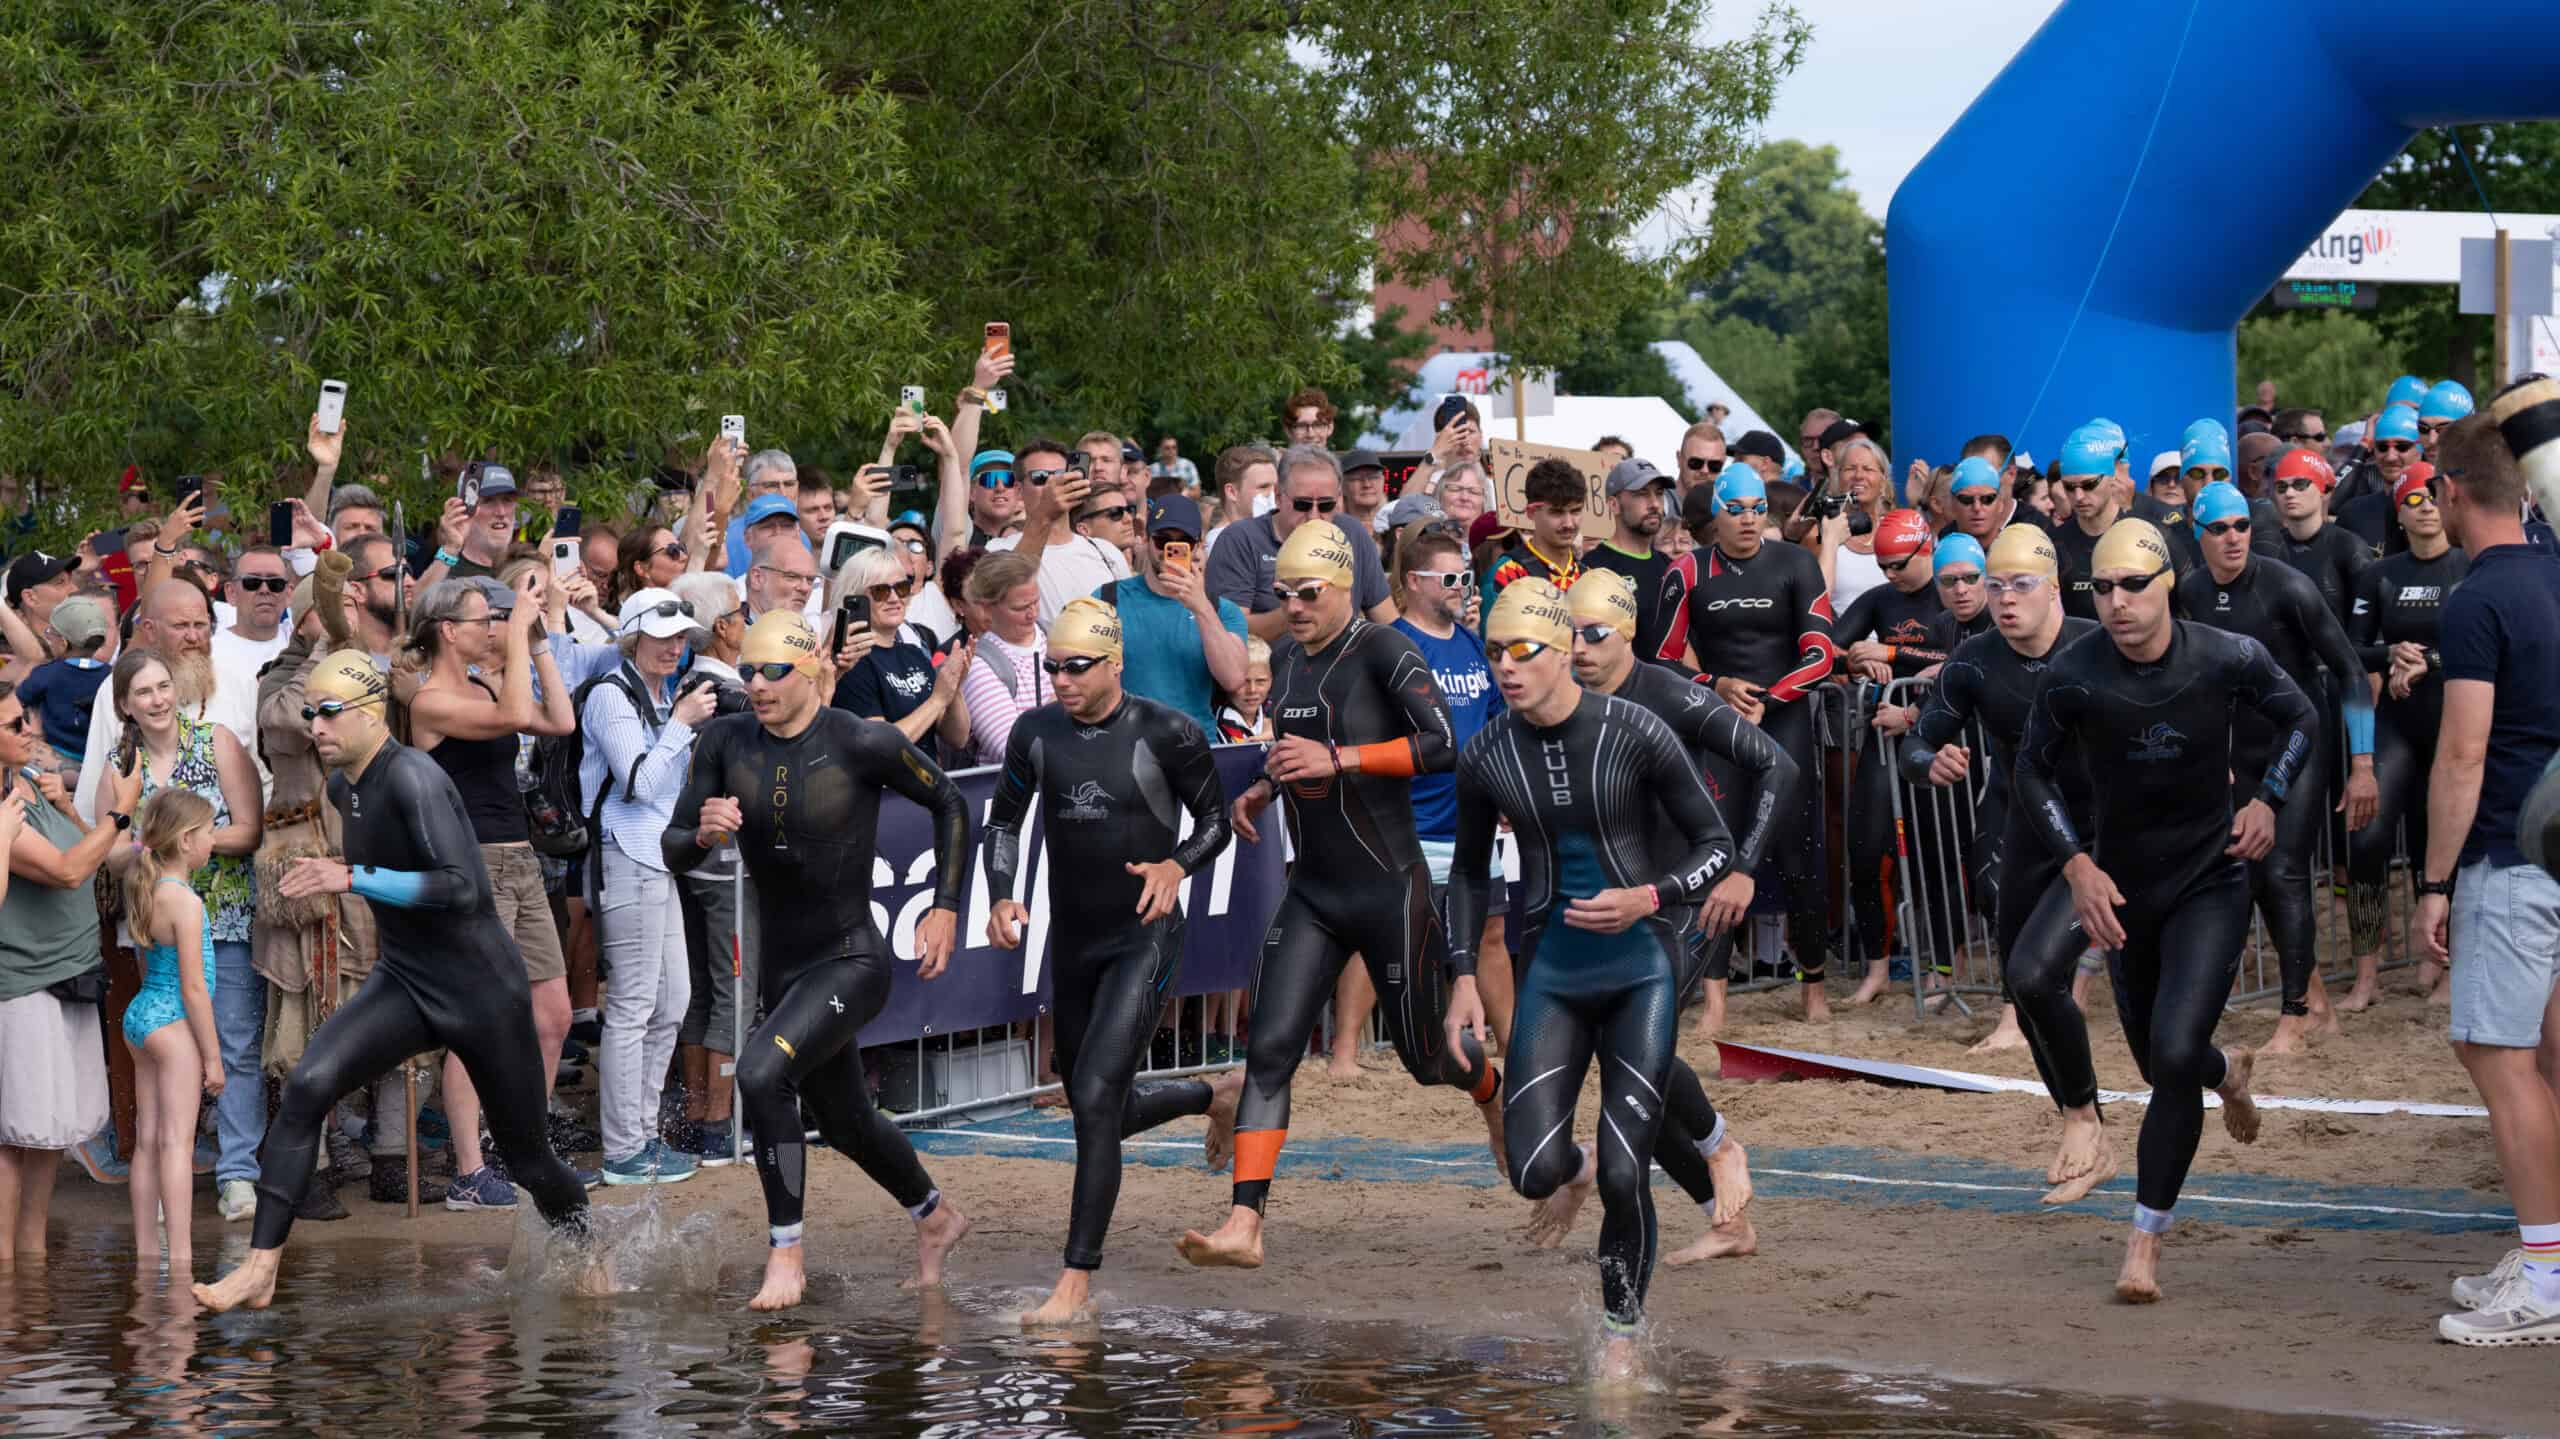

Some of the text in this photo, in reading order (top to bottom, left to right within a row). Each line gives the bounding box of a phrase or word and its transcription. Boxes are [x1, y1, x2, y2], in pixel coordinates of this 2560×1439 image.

[1707, 598, 1774, 612] orca
[1282, 705, 1319, 719] ZONE3
[1542, 739, 1573, 806] HUUB
[1686, 847, 1728, 891] HUUB
